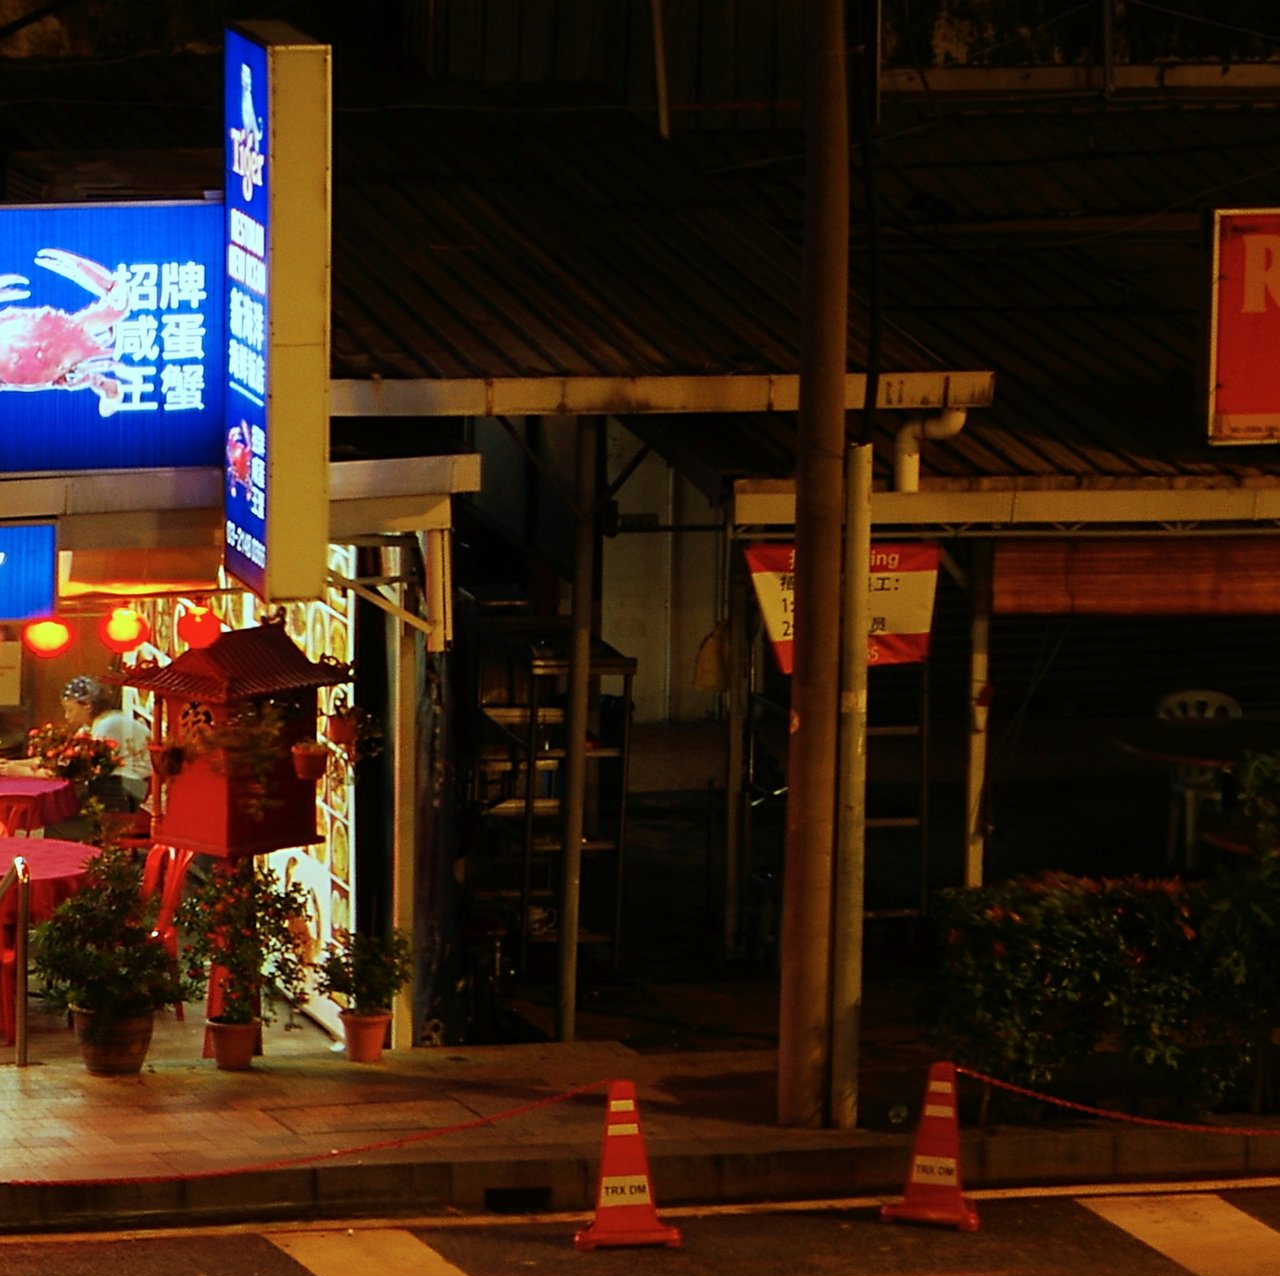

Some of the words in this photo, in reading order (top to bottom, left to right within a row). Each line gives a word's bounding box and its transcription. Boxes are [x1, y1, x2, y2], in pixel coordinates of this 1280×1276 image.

[230, 127, 265, 201] Tiger
[112, 261, 207, 310] 招牌
[112, 313, 207, 362] 咸蛋
[114, 363, 207, 411] 王蟹
